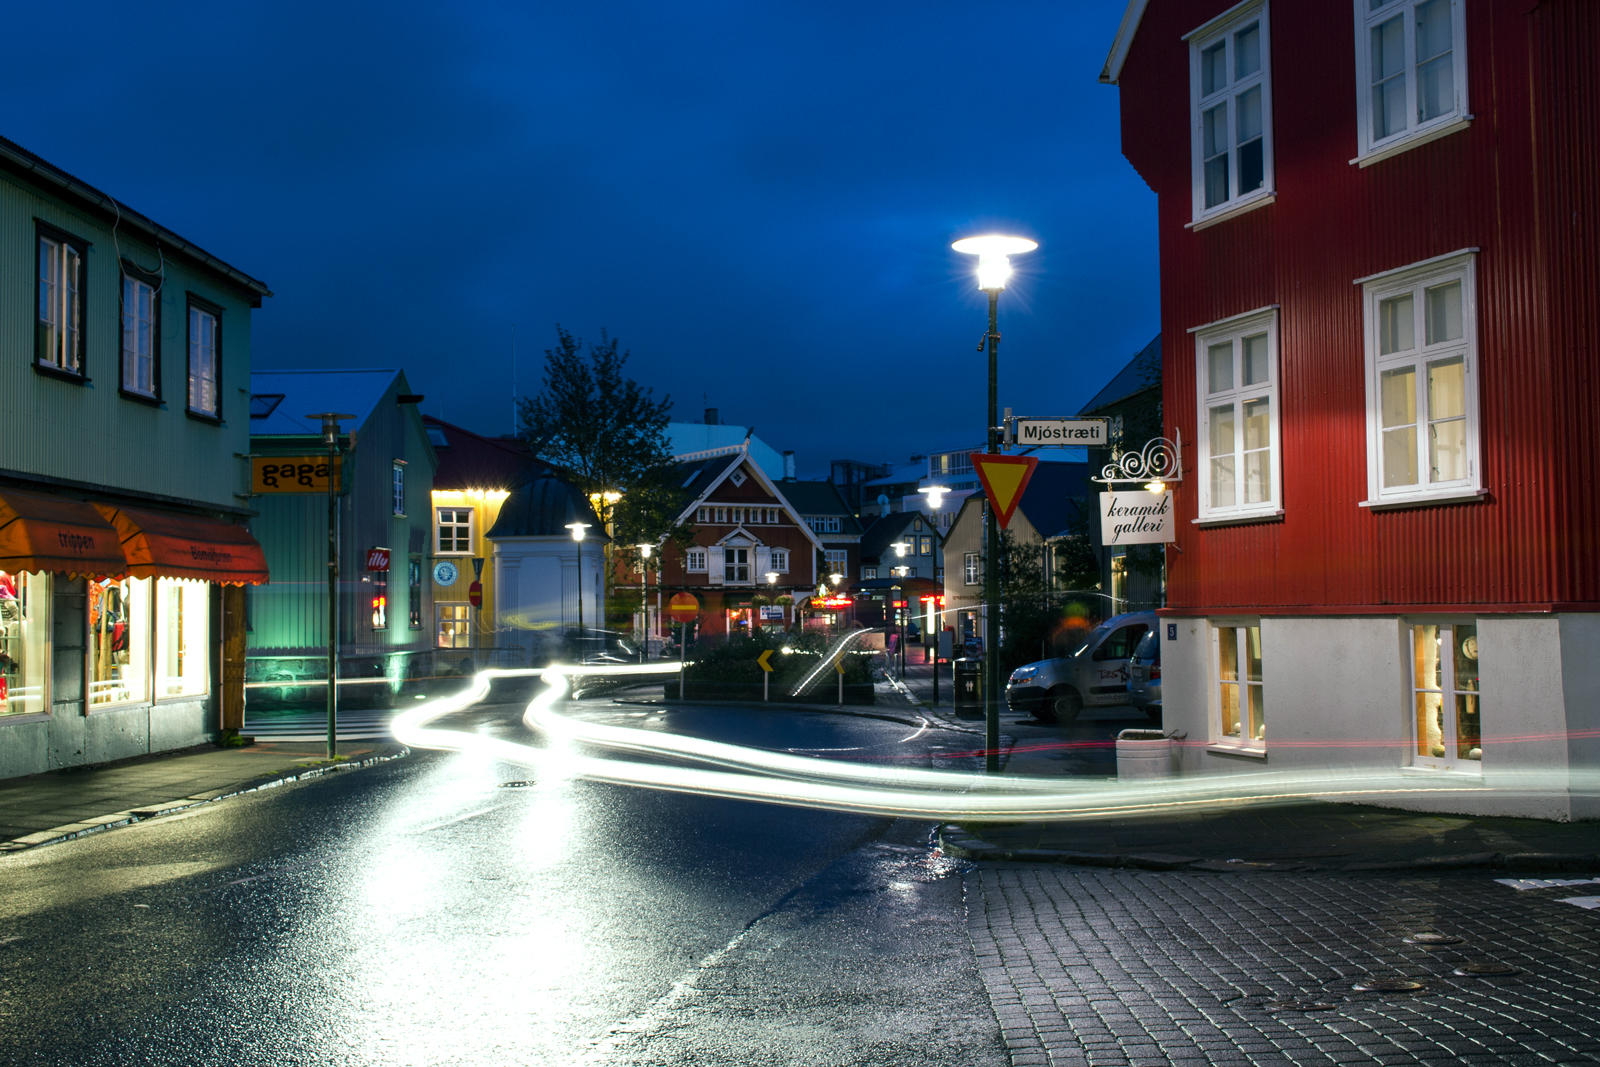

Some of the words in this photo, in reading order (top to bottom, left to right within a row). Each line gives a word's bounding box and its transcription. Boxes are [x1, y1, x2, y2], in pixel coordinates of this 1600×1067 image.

[1024, 426, 1099, 441] Mjóstræti
[262, 464, 330, 488] gaga
[1107, 496, 1170, 517] keramik
[1112, 516, 1165, 543] galleri
[58, 530, 95, 554] trippen
[368, 552, 388, 569] illy
